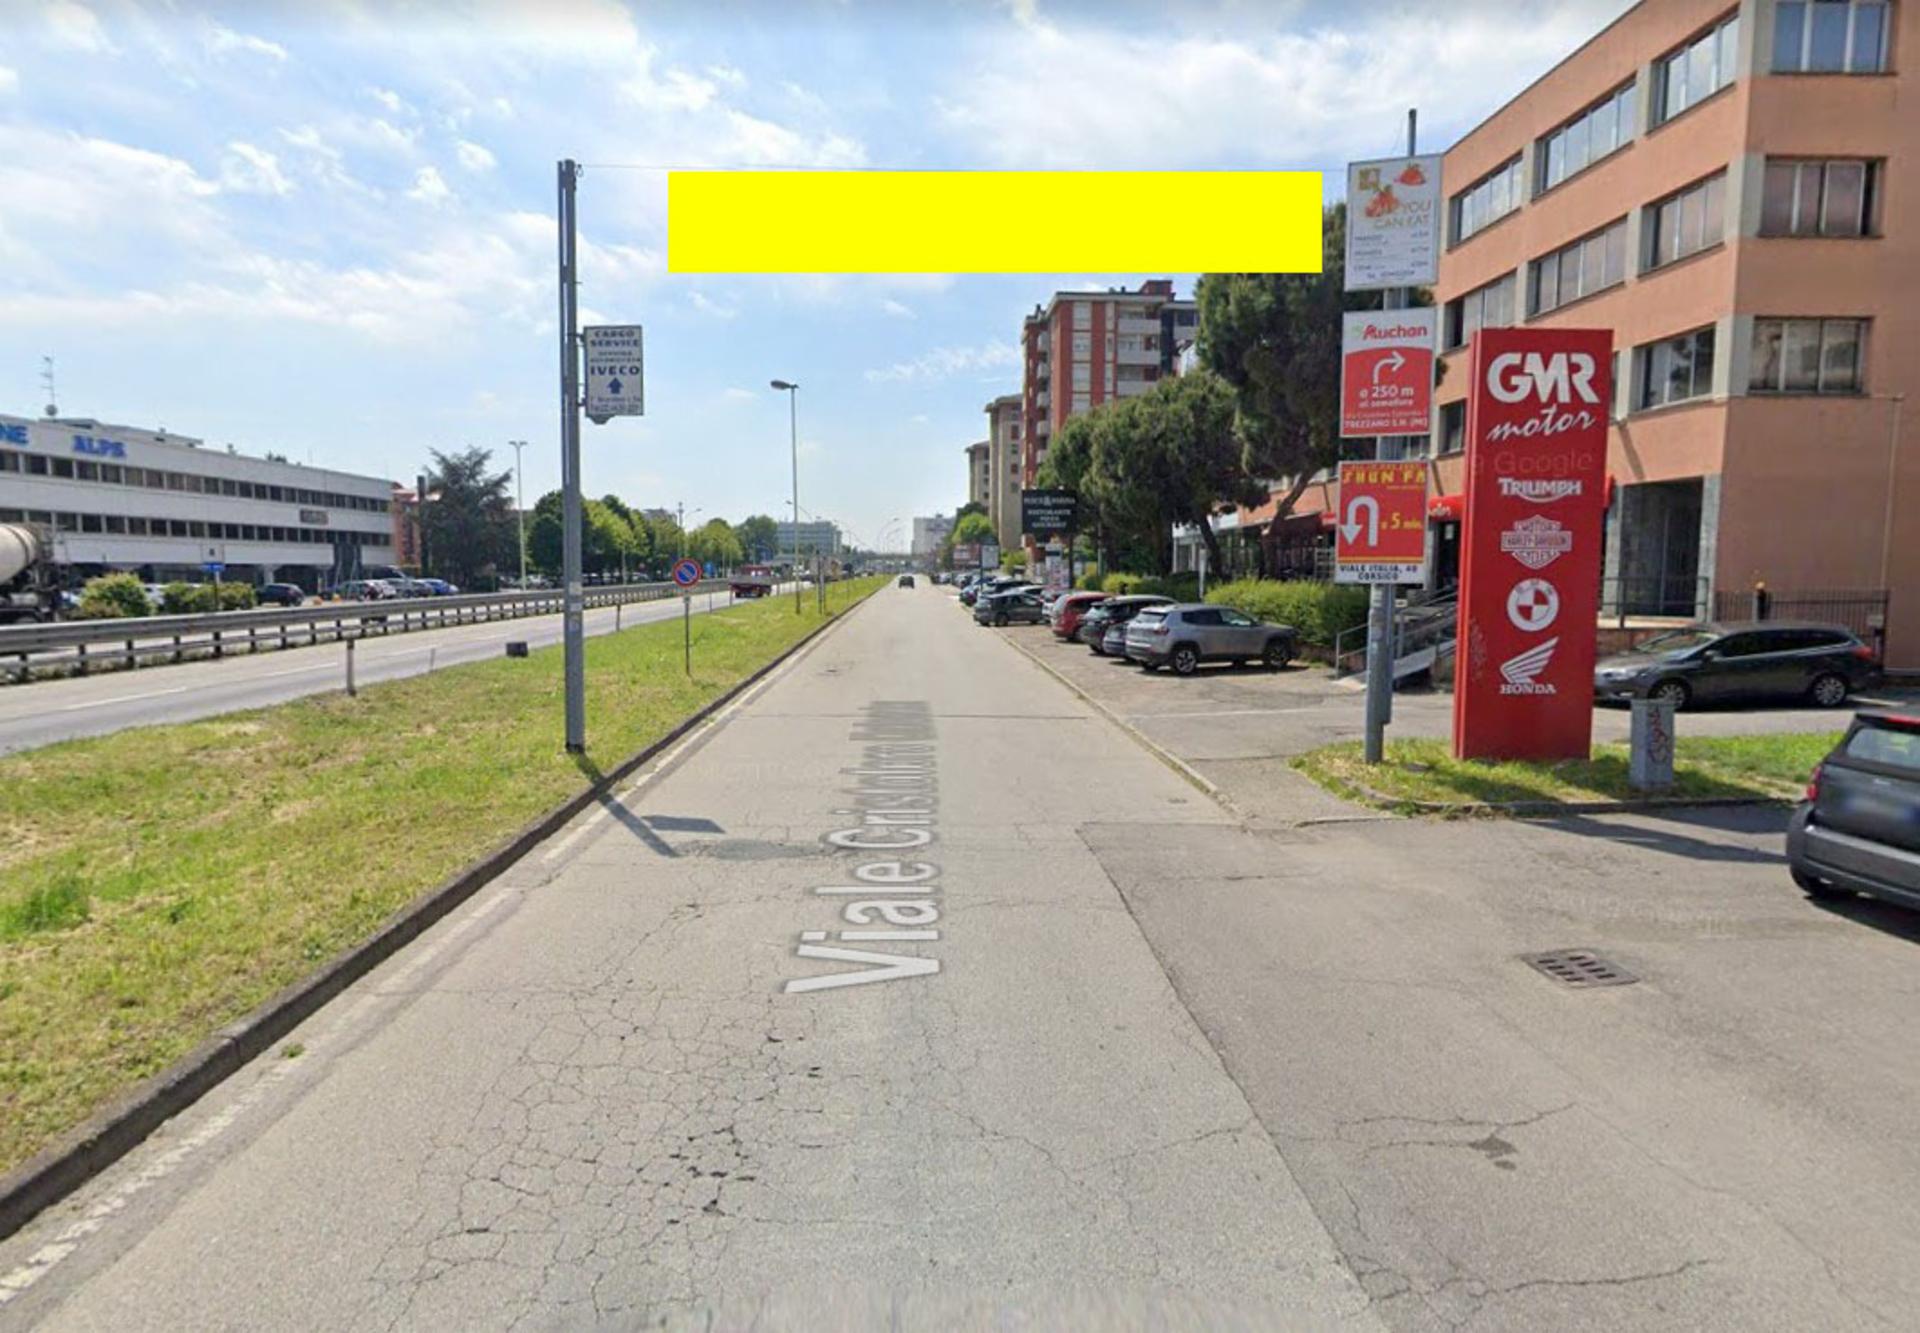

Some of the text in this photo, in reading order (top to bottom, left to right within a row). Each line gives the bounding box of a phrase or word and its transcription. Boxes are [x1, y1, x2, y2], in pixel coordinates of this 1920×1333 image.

[1362, 324, 1428, 340] Auchan
[591, 366, 640, 375] IVECO
[1487, 353, 1600, 403] GMR
[1372, 385, 1398, 398] 250
[1401, 387, 1414, 397] m
[1487, 404, 1596, 441] motor
[1497, 477, 1583, 497] TRIUMPH
[1391, 512, 1400, 529] 5
[1500, 683, 1557, 694] HONDA
